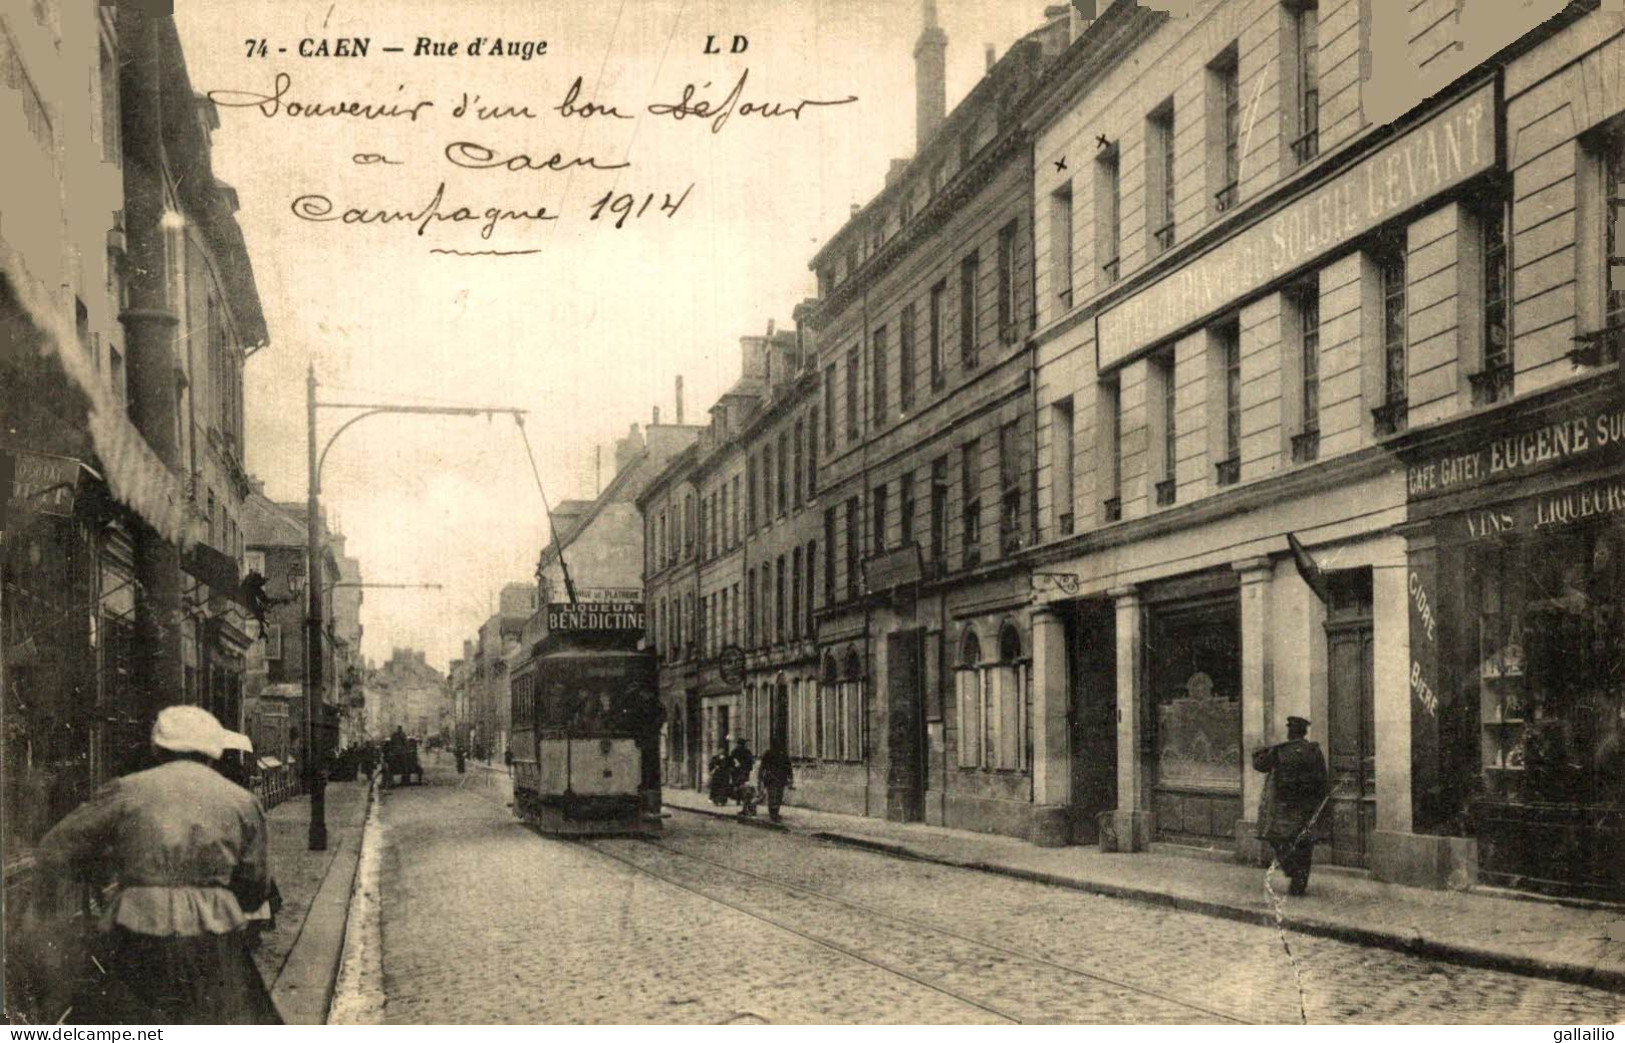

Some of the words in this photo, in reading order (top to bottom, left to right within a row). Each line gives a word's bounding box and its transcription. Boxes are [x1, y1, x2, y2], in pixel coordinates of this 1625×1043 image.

[208, 72, 434, 121] Souvenir
[452, 92, 537, 120] d'un
[553, 76, 635, 118] bon
[445, 141, 631, 171] Caen
[291, 182, 559, 240] Campagne
[590, 182, 695, 229] 1914
[1272, 182, 1359, 271] SOLEIL
[1366, 102, 1484, 218] LEVANT
[1467, 511, 1514, 538] VINS
[563, 603, 635, 613] LIQUEUR
[1408, 571, 1436, 641] CIDRE
[1410, 660, 1438, 718] BIERE
